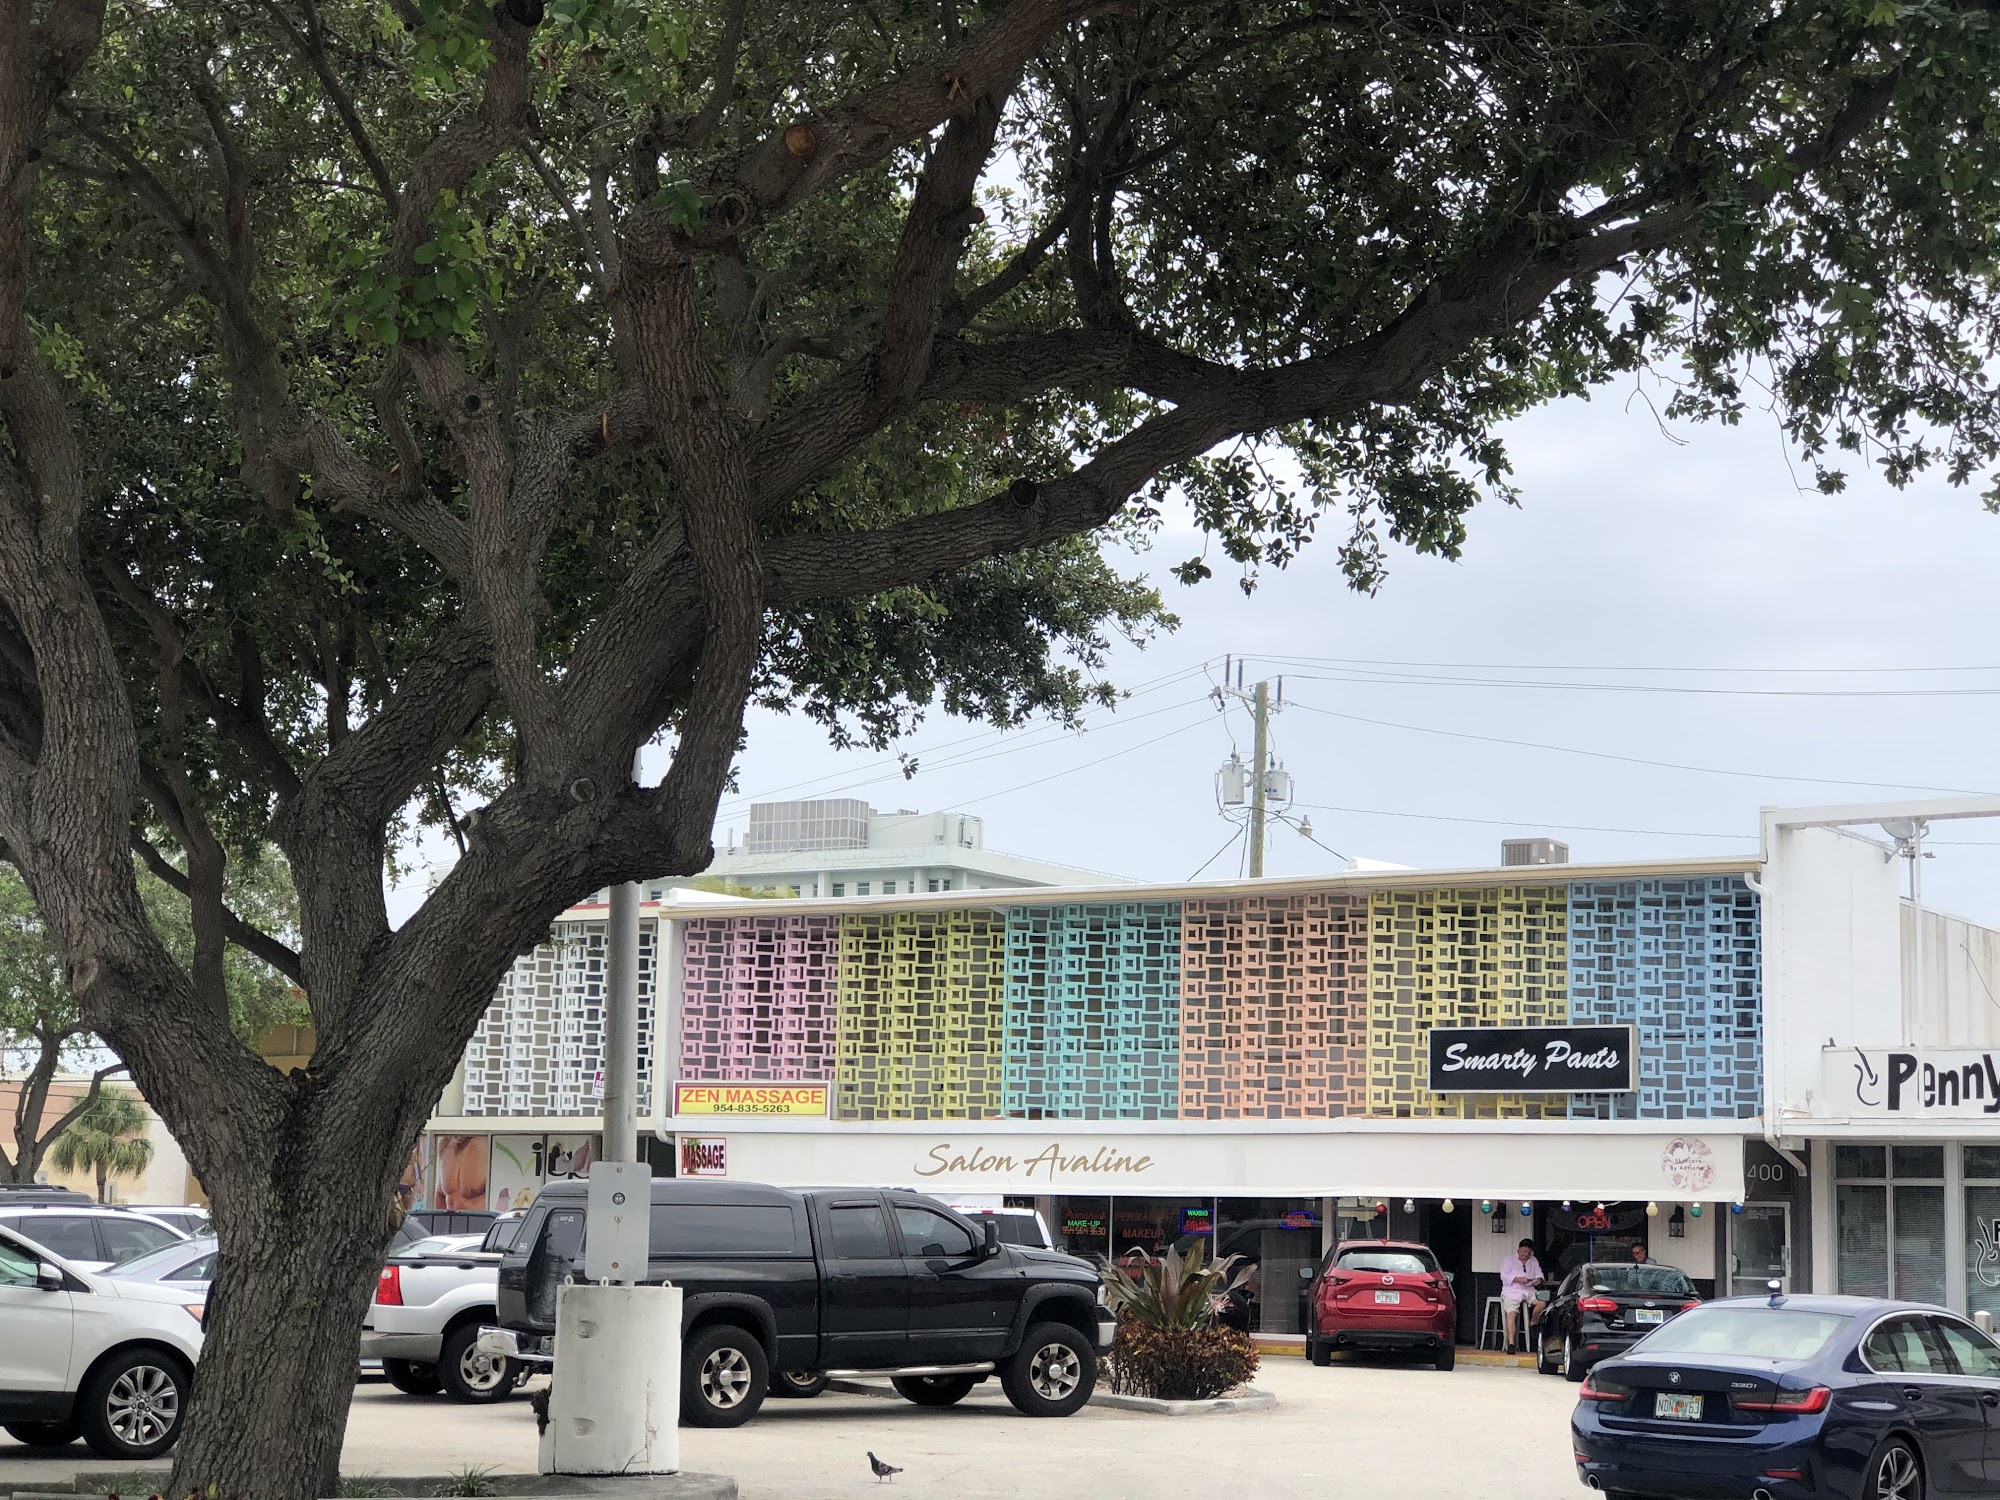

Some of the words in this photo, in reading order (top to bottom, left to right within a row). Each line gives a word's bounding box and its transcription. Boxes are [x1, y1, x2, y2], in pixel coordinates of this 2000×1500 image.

[1441, 1042, 1538, 1078] Smarty
[1544, 1040, 1620, 1071] Pants
[682, 1089, 720, 1103] ZEN
[725, 1089, 823, 1104] MASSAGE
[713, 1104, 790, 1113] 954-835-5263
[683, 1144, 725, 1169] MASSAGE
[913, 1143, 1018, 1176] Salon
[1023, 1143, 1154, 1182] Avaline
[1747, 1164, 1783, 1181] 400
[1187, 1209, 1209, 1217] WAXING
[1067, 1219, 1101, 1227] MAKE-UP
[1578, 1215, 1611, 1229] OPEN
[1122, 1228, 1164, 1239] MAKEUP
